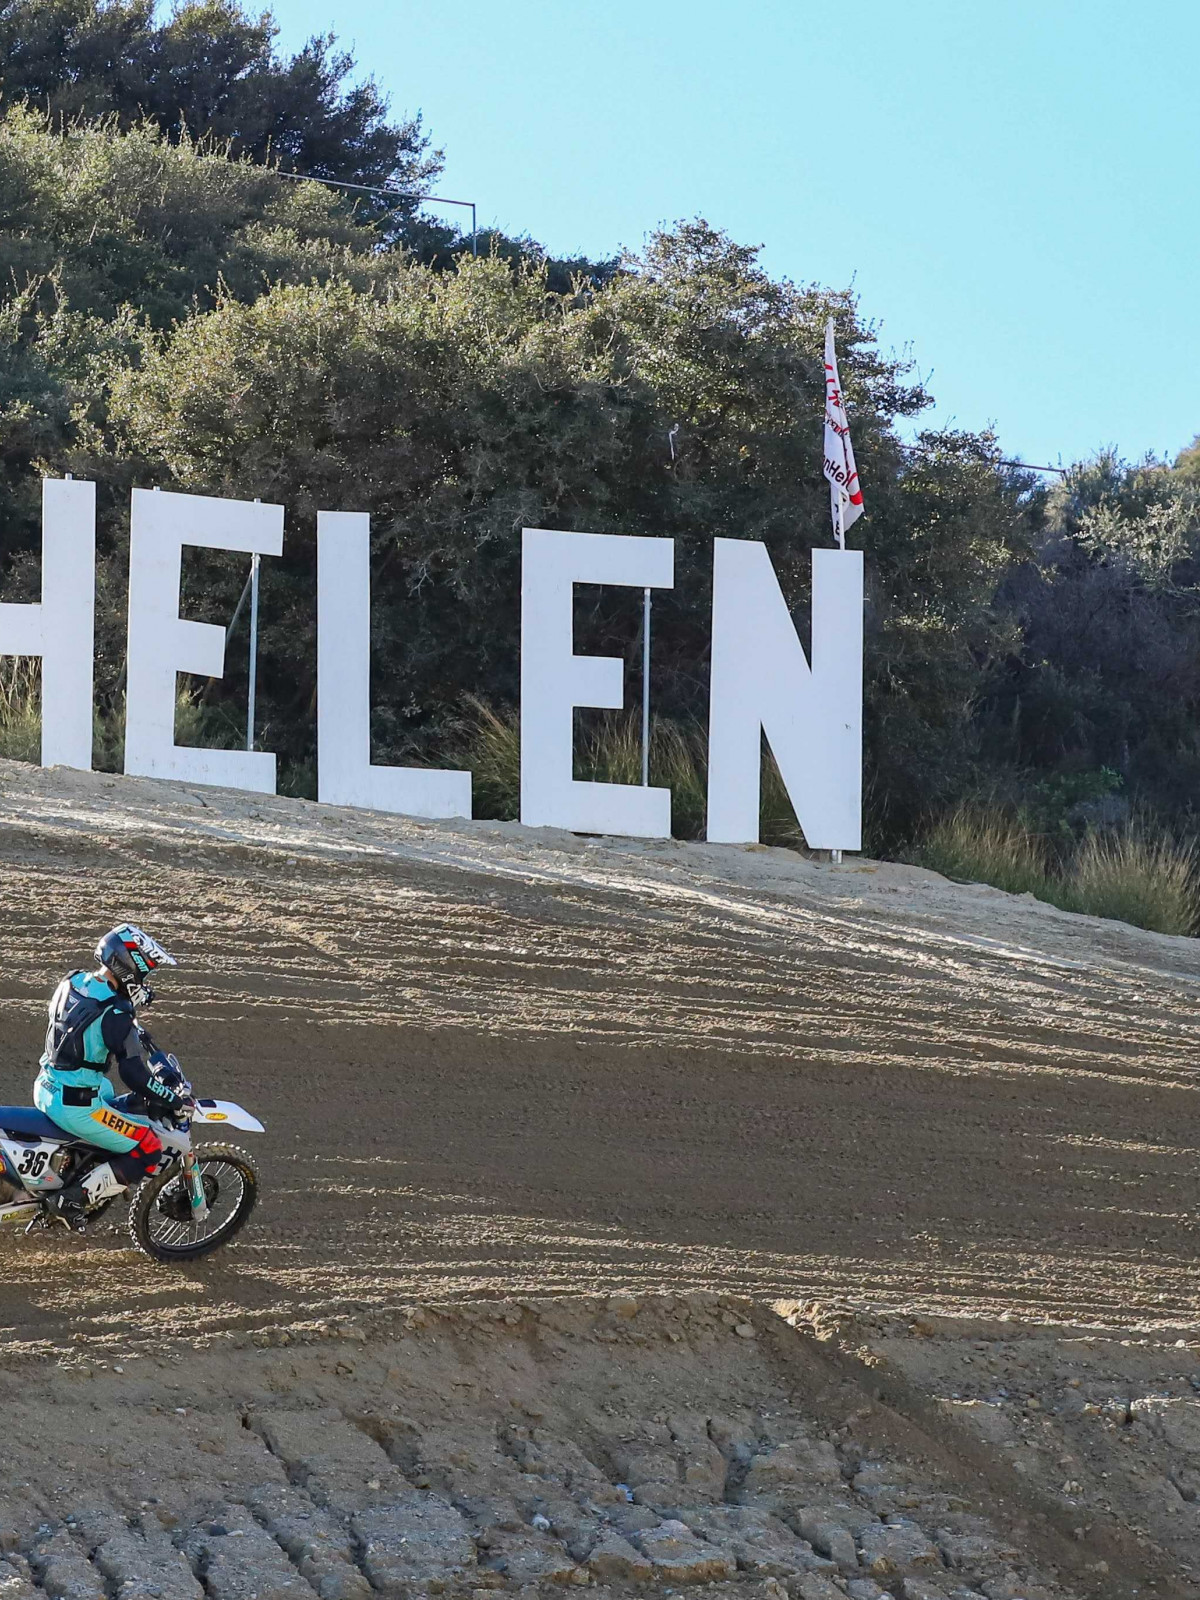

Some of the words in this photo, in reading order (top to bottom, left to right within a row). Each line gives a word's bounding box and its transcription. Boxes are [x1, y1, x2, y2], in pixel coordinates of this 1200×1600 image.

[130, 950, 150, 973] LEATT
[146, 1076, 175, 1102] LEATT
[102, 1111, 140, 1138] LEATT
[17, 1149, 49, 1177] 36
